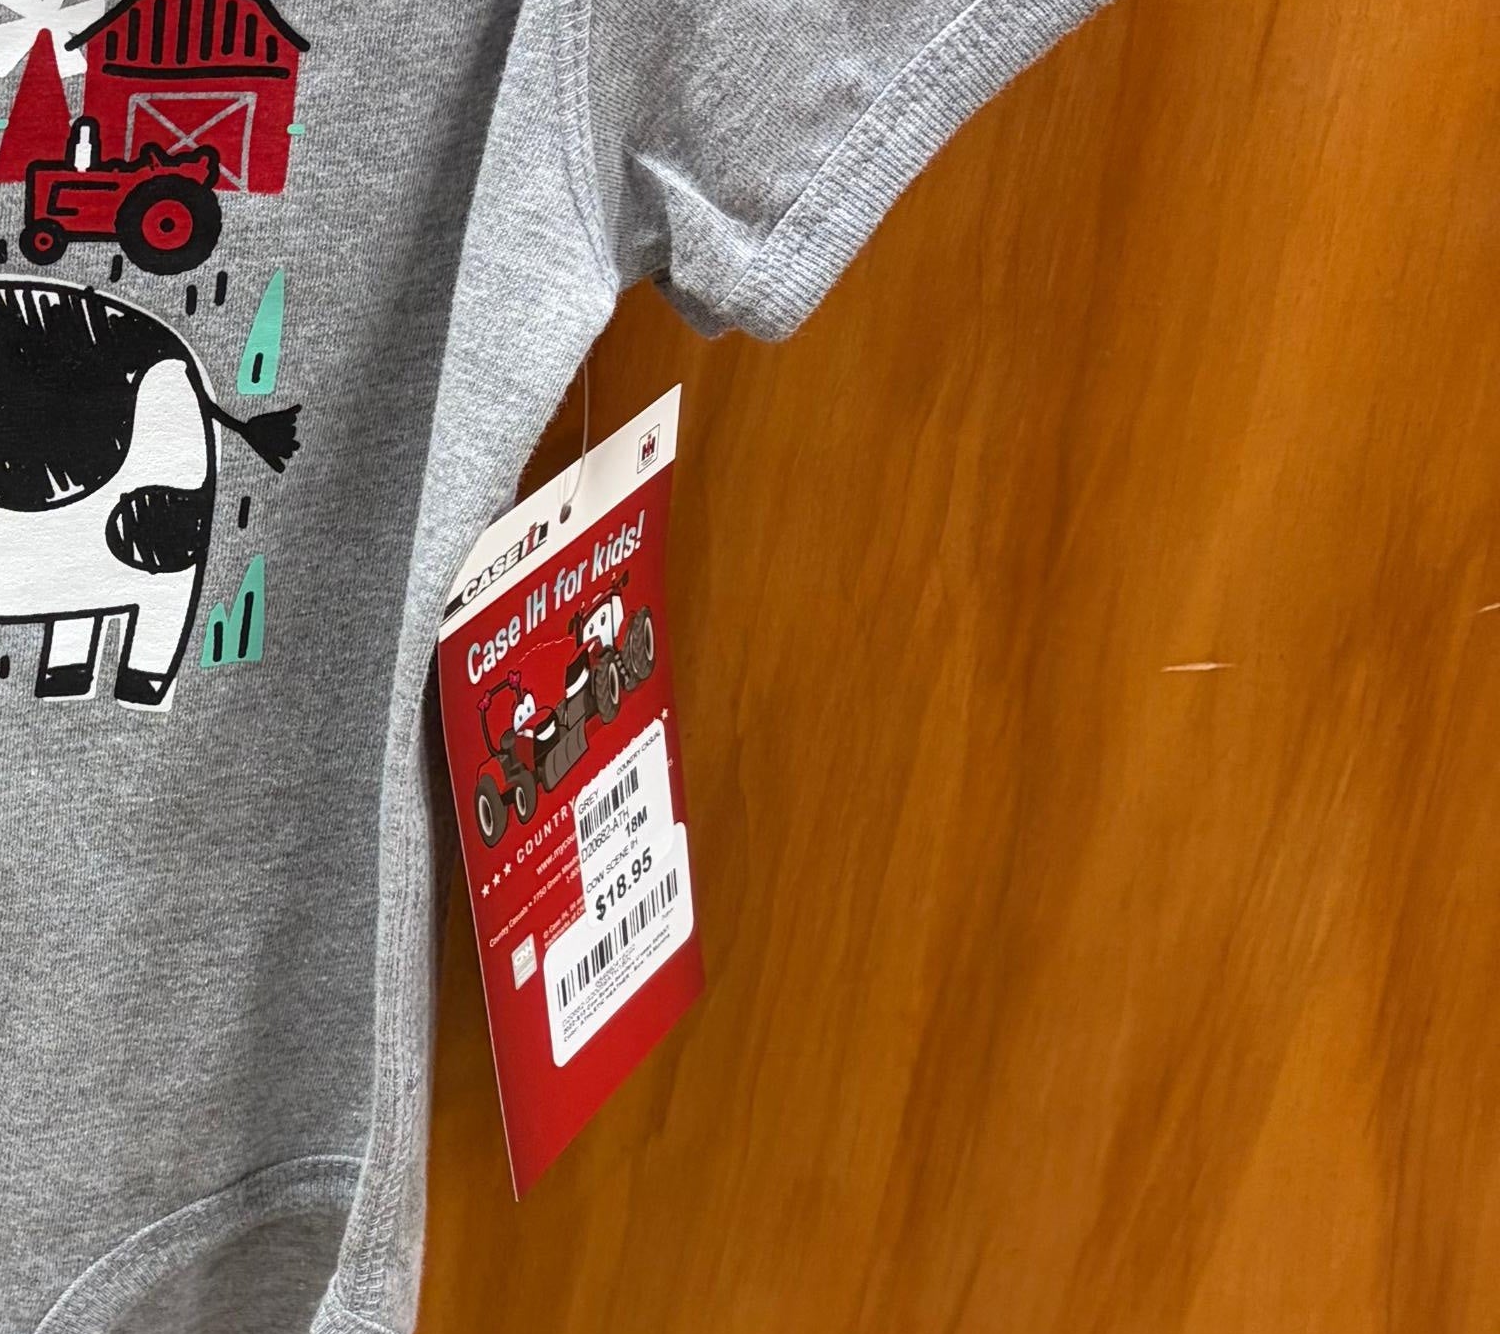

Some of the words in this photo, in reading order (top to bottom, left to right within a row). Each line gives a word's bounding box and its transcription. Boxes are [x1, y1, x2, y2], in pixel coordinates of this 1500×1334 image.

[467, 615, 521, 685] Case
[526, 582, 548, 635] IH
[553, 559, 588, 611] for
[591, 509, 646, 582] kids!
[616, 749, 641, 776] COUNTRY
[578, 788, 600, 815] GREY
[625, 805, 648, 838] 18M
[581, 806, 631, 864] D20682-ATH
[586, 870, 605, 894] COW
[606, 845, 630, 875] SCENE
[595, 846, 653, 922] $18.95
